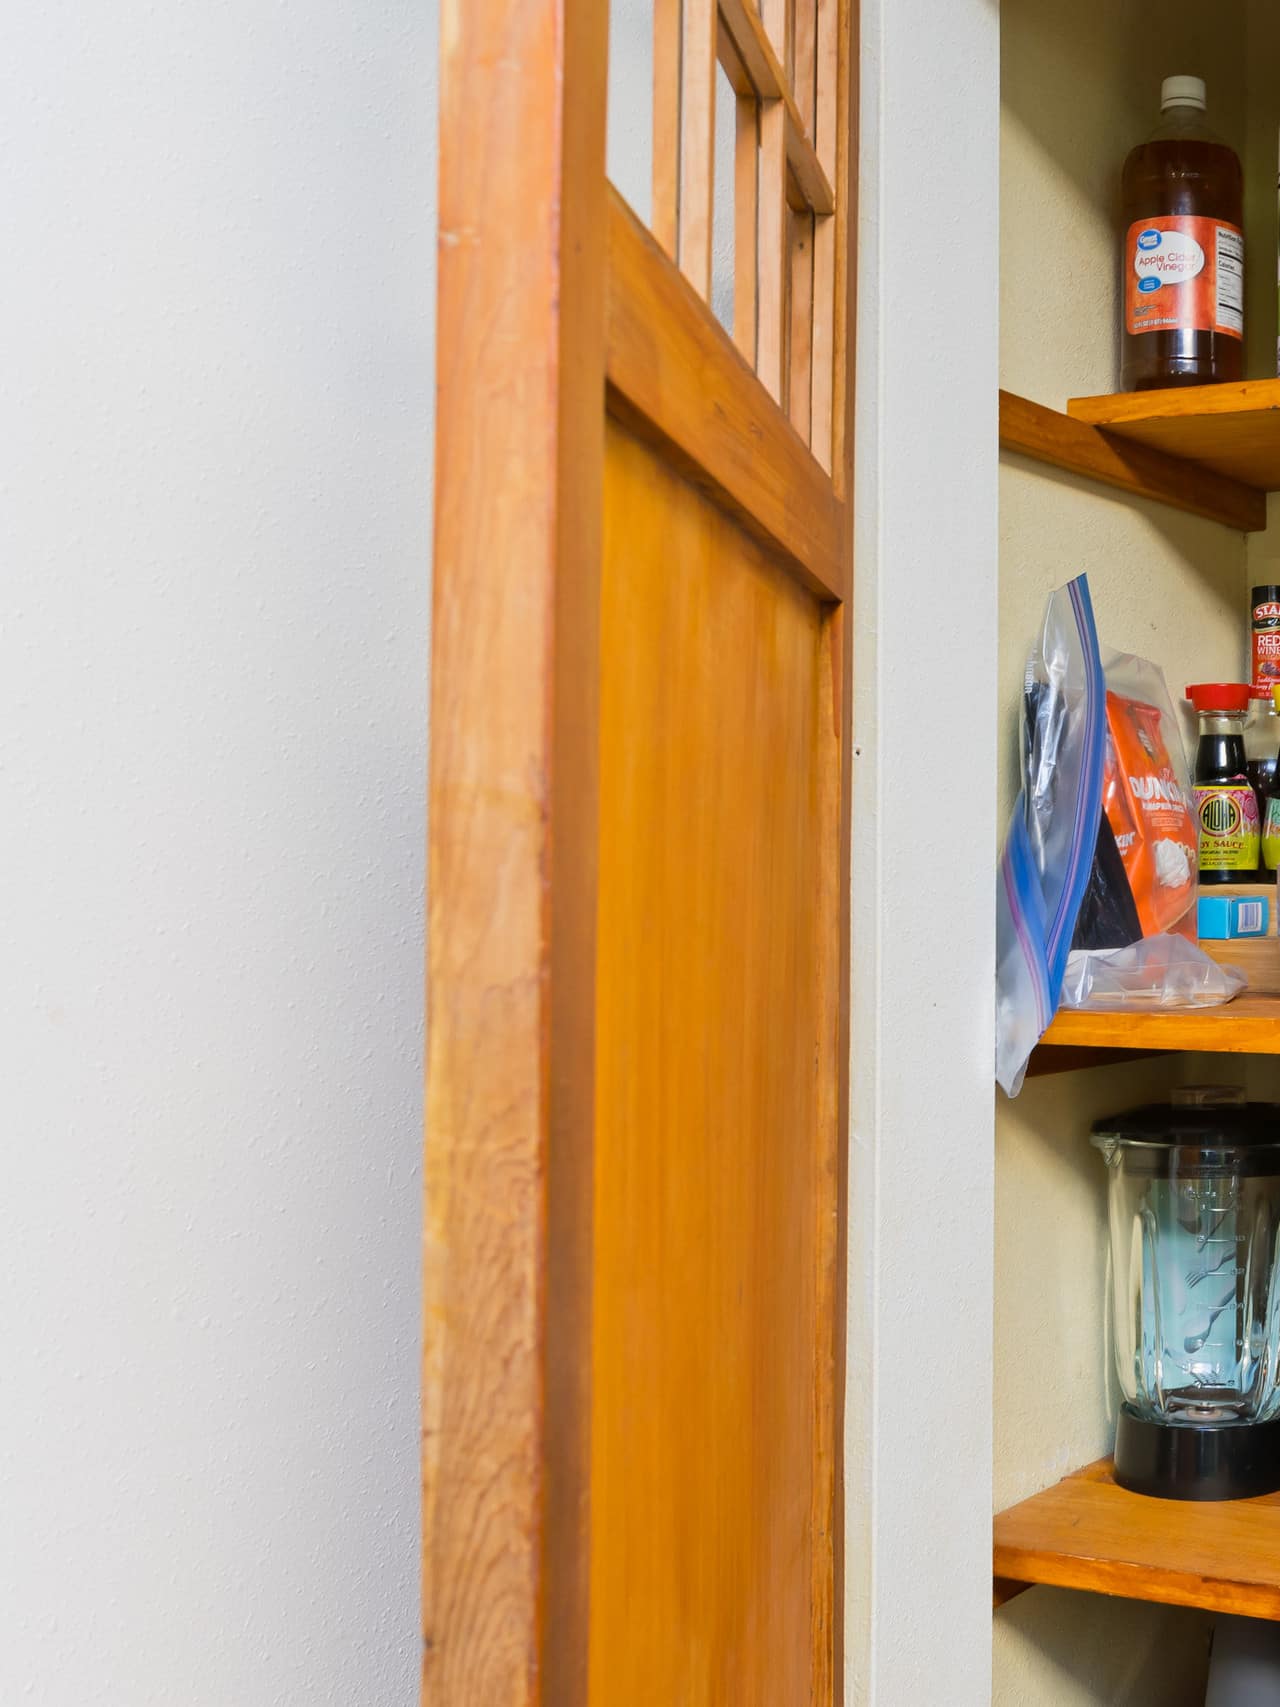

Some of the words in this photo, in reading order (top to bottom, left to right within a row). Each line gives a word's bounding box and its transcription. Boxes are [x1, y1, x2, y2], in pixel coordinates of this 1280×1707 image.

[1138, 254, 1165, 267] Apple
[1157, 261, 1196, 273] Vinegar
[1202, 799, 1237, 831] ALOHA
[1213, 840, 1244, 849] SAUCE
